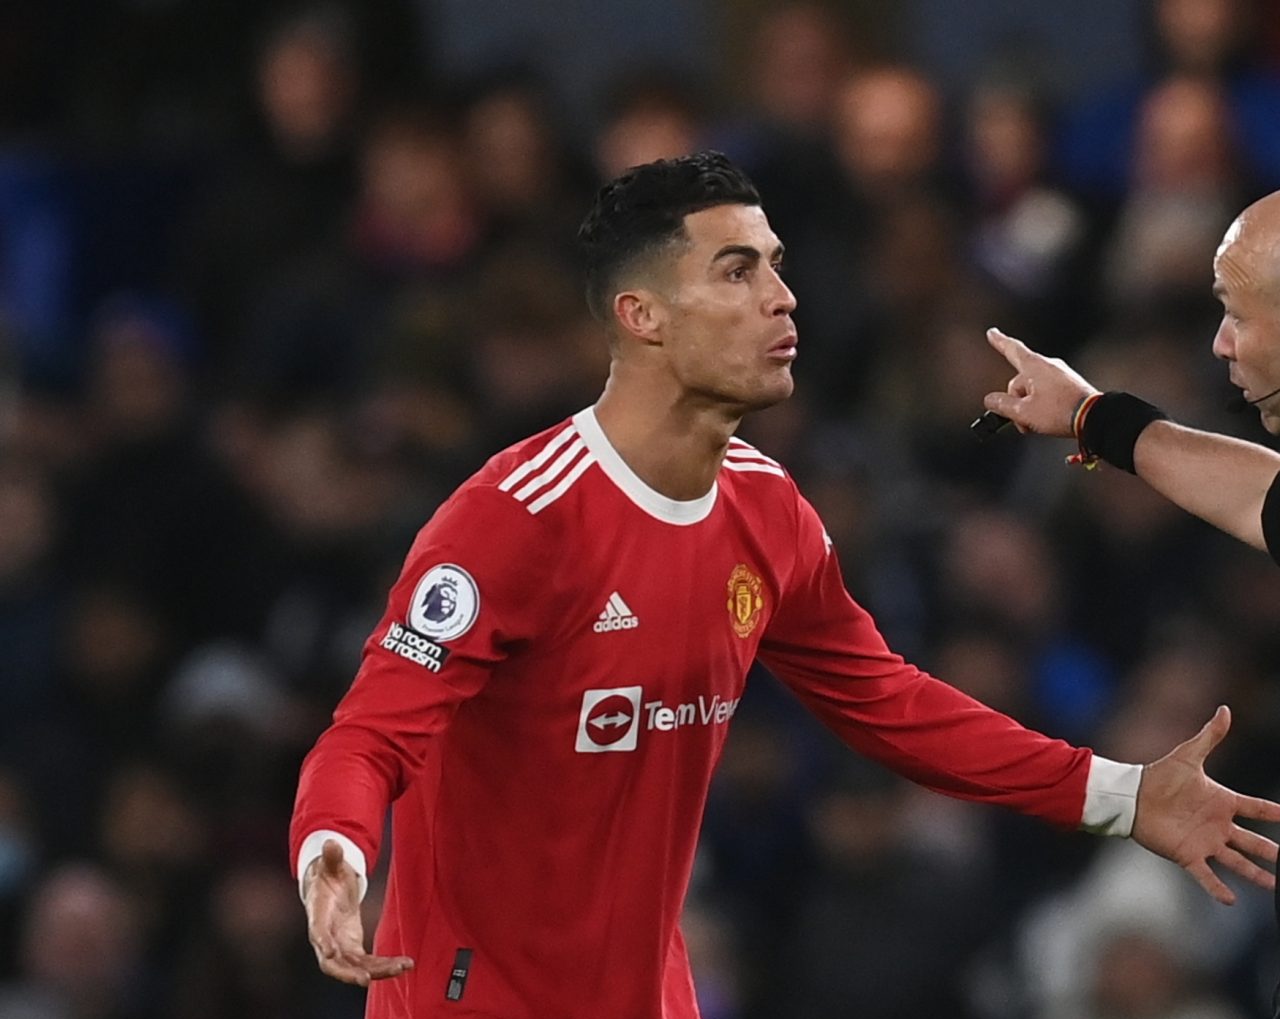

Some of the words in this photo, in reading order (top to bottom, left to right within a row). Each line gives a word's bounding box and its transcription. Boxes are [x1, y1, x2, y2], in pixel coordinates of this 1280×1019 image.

[593, 614, 639, 633] adidas
[402, 631, 442, 659] room
[644, 694, 741, 731] TemView
